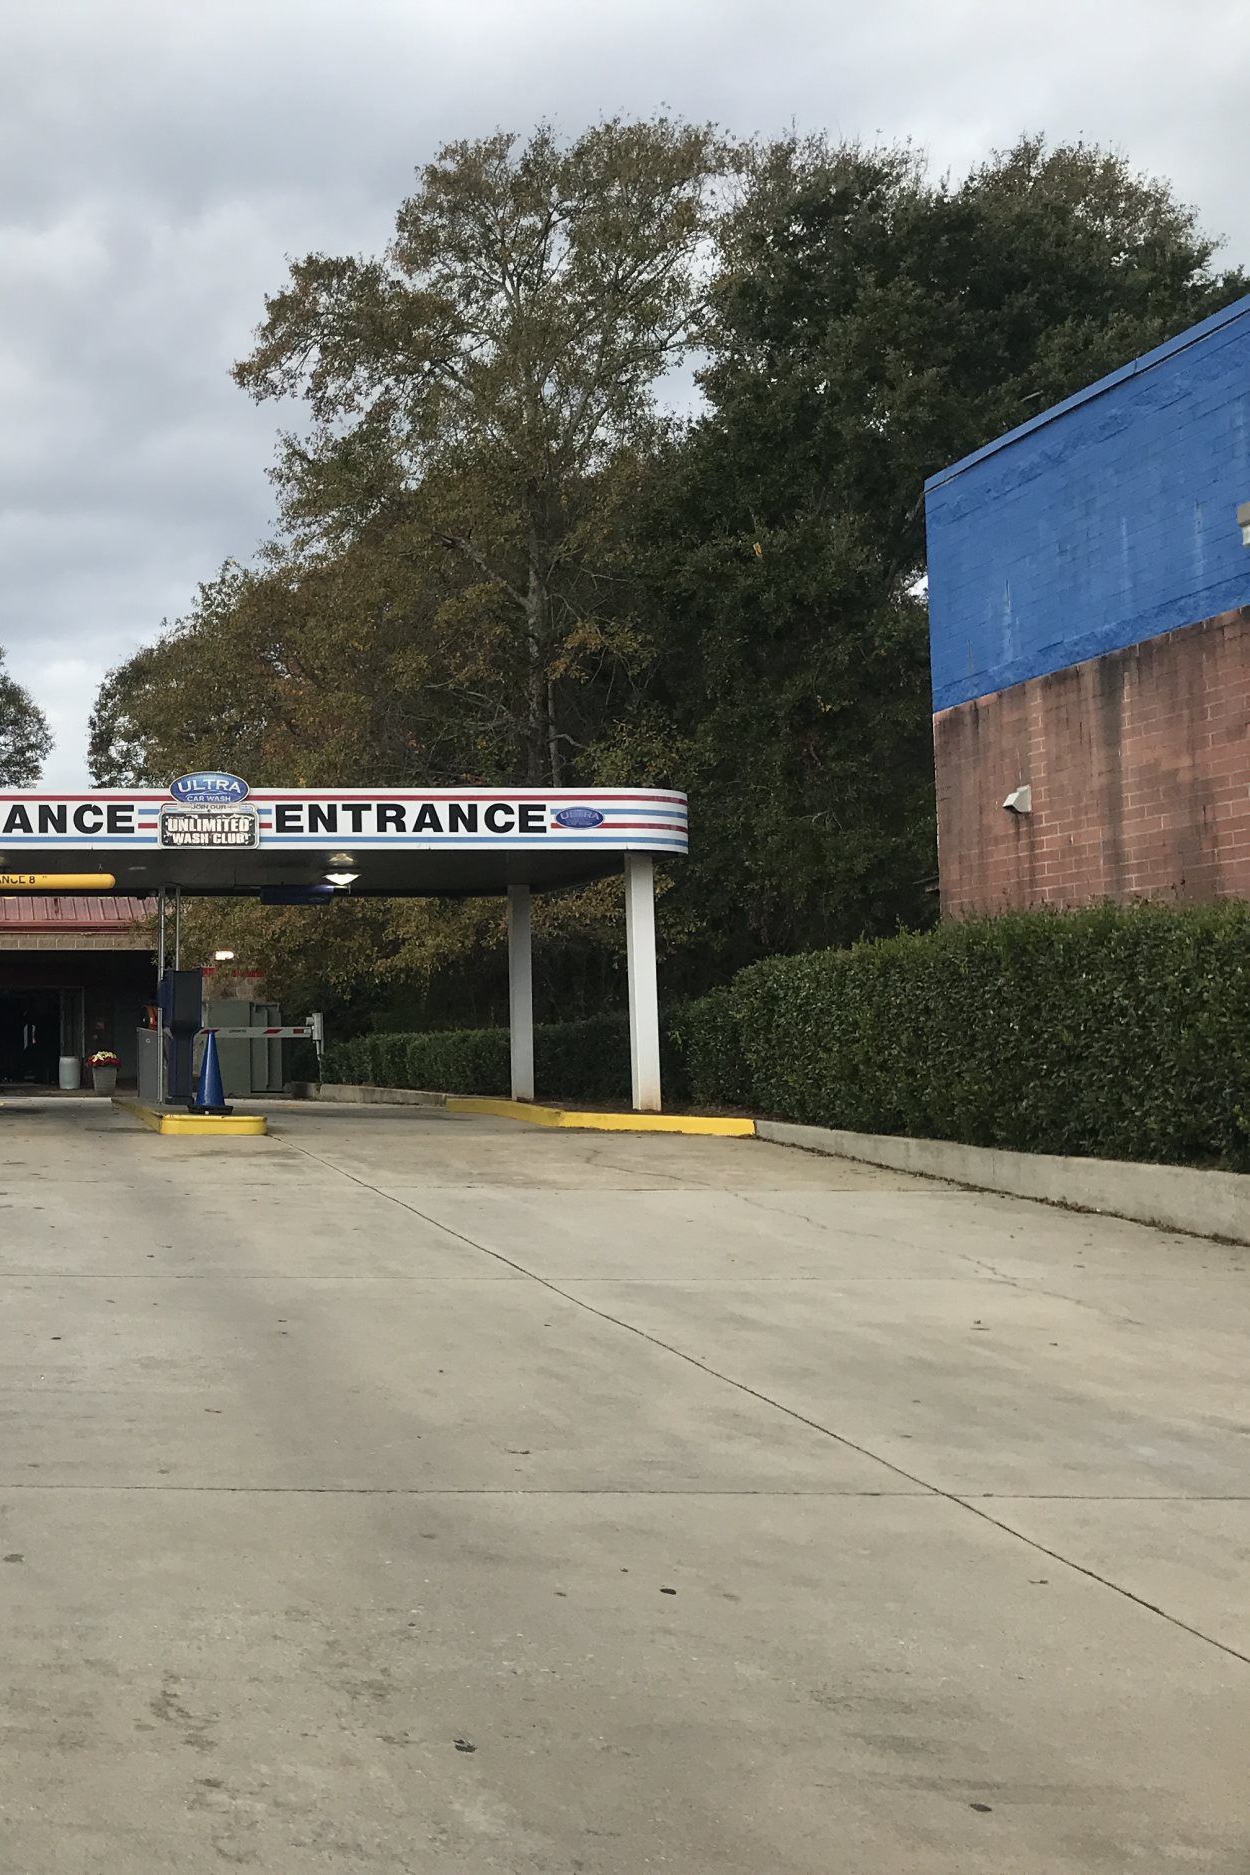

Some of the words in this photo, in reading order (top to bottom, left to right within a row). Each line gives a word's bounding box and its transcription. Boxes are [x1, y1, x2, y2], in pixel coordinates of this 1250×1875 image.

[177, 779, 241, 794] ULTRA
[167, 818, 250, 832] UNLIMITED
[275, 803, 547, 833] ENTRANCE
[172, 833, 209, 844] WASH
[212, 833, 249, 845] CLUB!
